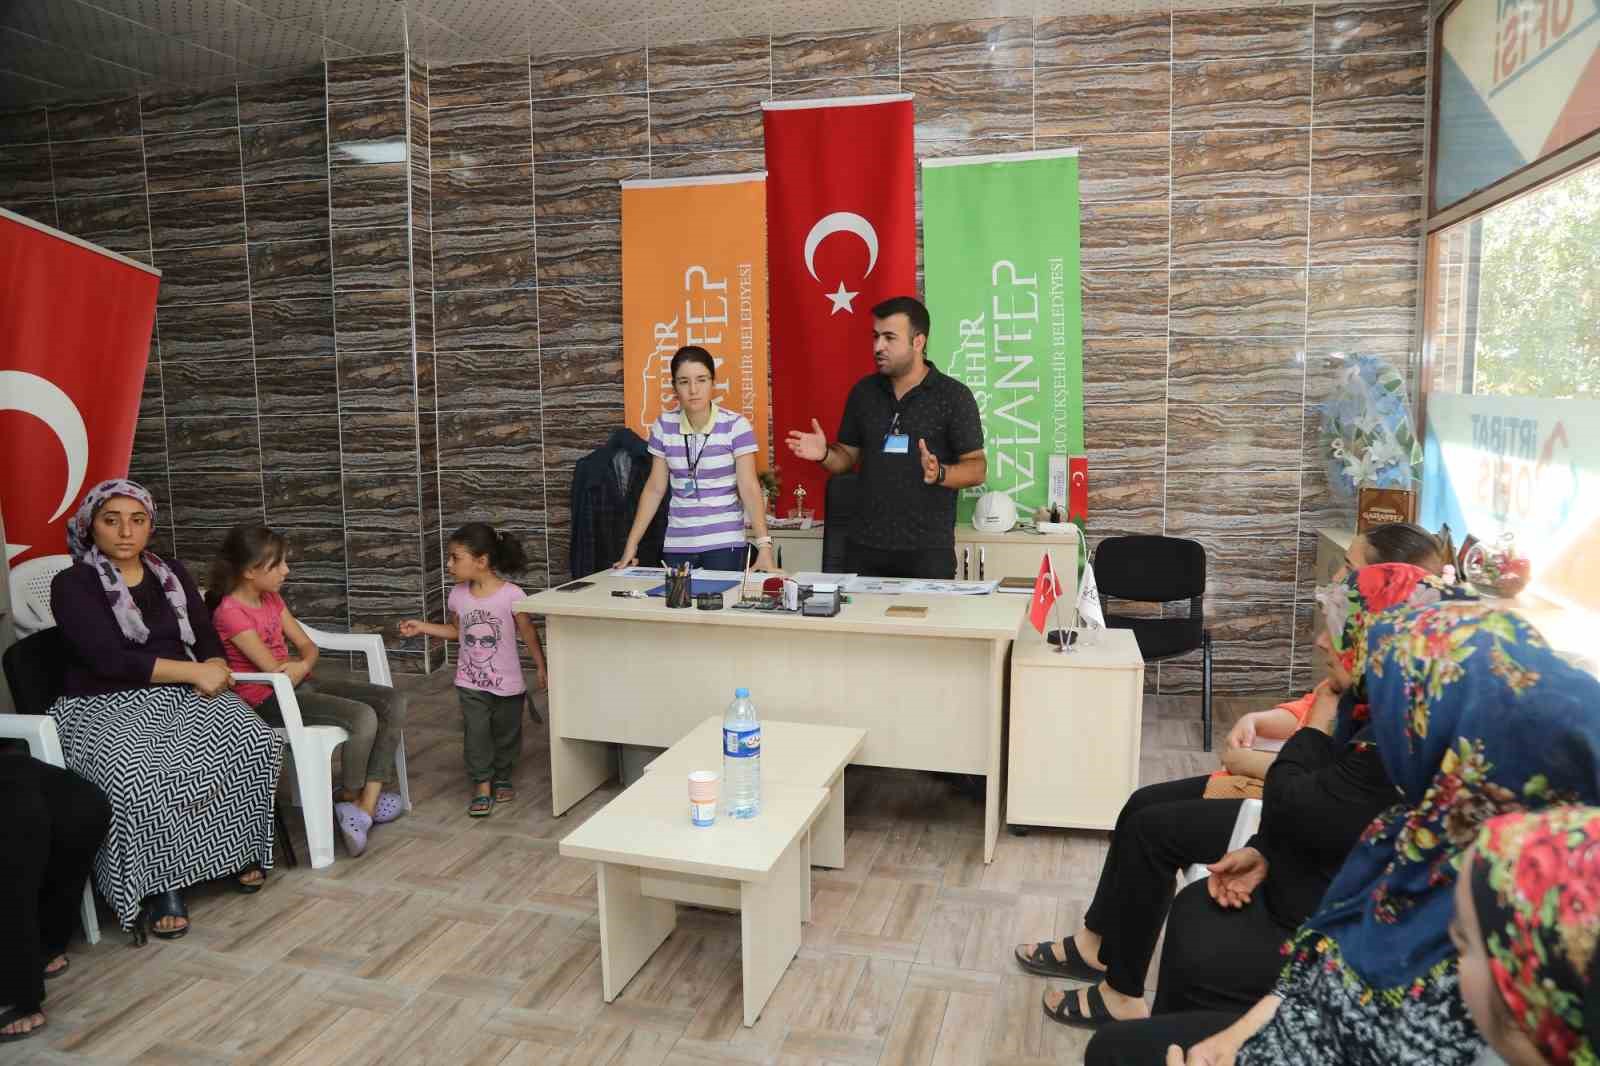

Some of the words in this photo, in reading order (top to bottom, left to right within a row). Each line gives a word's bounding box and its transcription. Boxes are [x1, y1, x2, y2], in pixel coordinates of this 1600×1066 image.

[737, 263, 753, 349] BELEDİYESİ
[1049, 255, 1066, 347] BELEDİYESİ
[990, 258, 1041, 516] AZİANTEP
[1051, 348, 1068, 454] BÜYÜKŞEHİR
